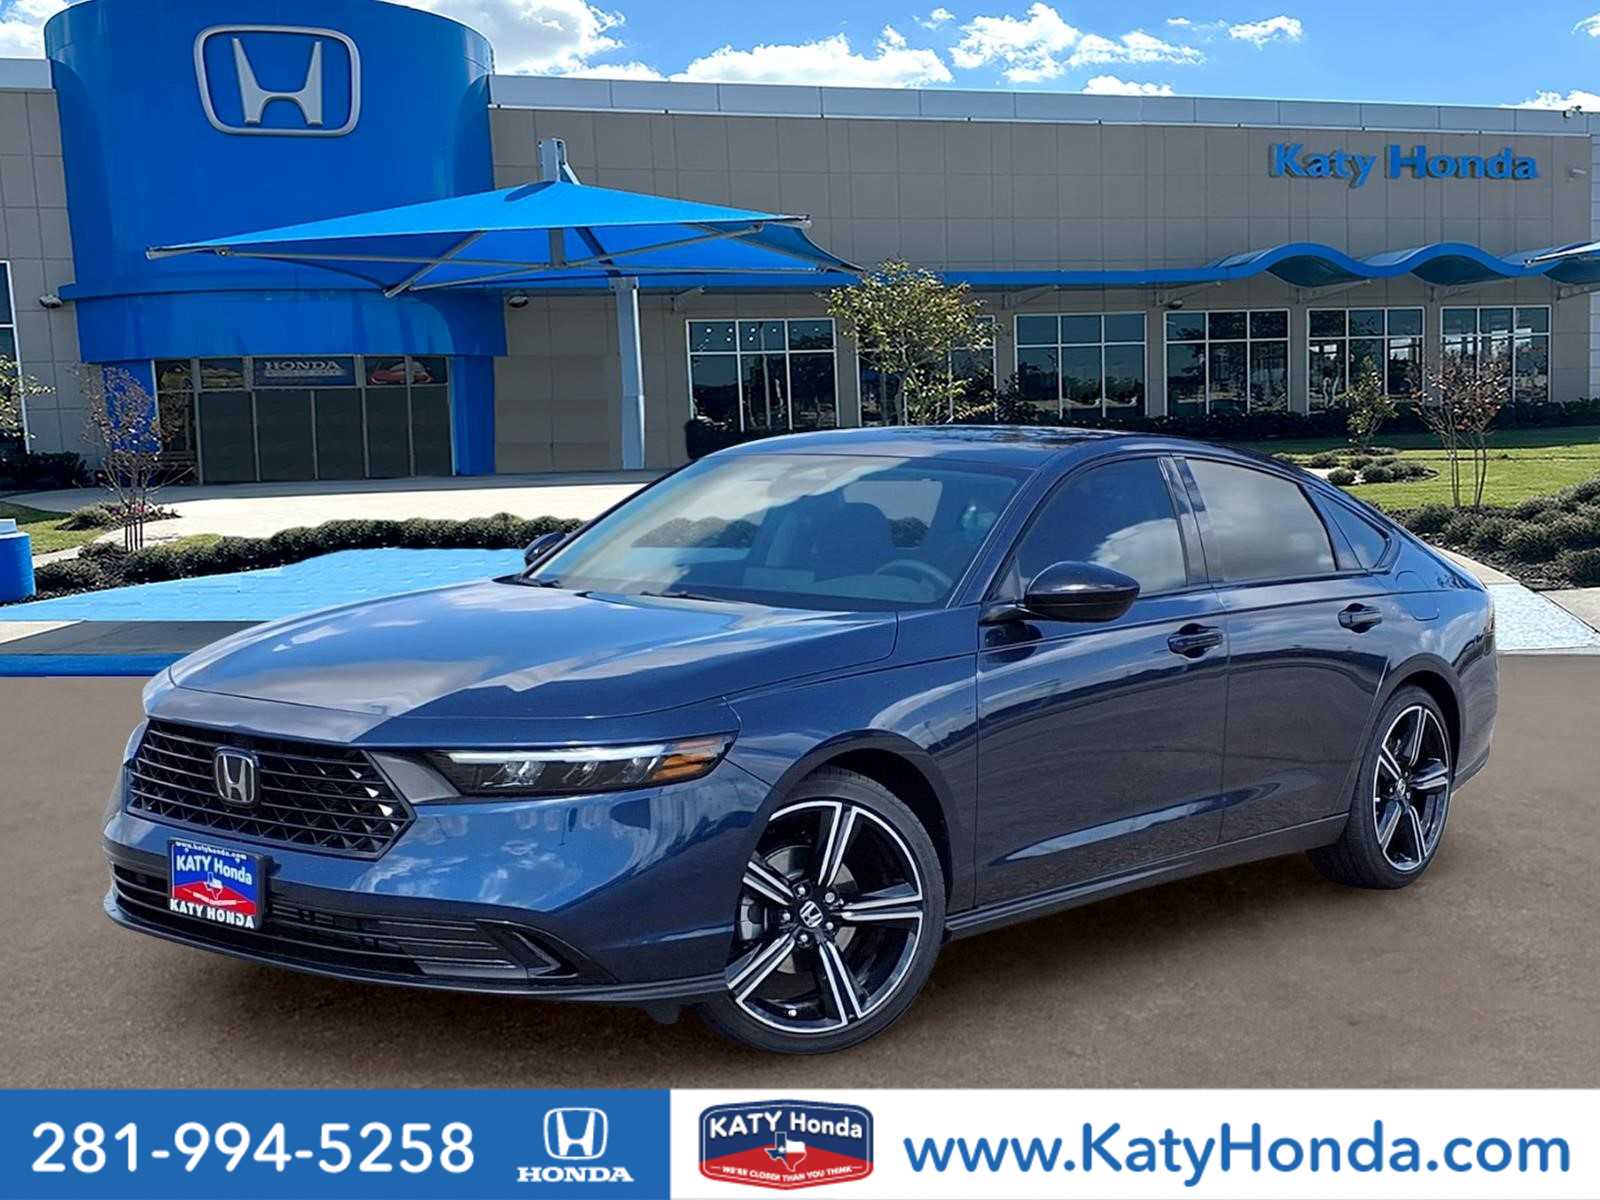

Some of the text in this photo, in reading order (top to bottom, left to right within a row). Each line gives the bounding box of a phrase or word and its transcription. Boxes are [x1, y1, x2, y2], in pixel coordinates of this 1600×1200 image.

[1270, 144, 1538, 188] Katy Honda
[264, 360, 342, 370] HONDA
[176, 855, 252, 885] KATY Honda
[170, 898, 203, 917] KATY
[206, 906, 255, 929] HONDA
